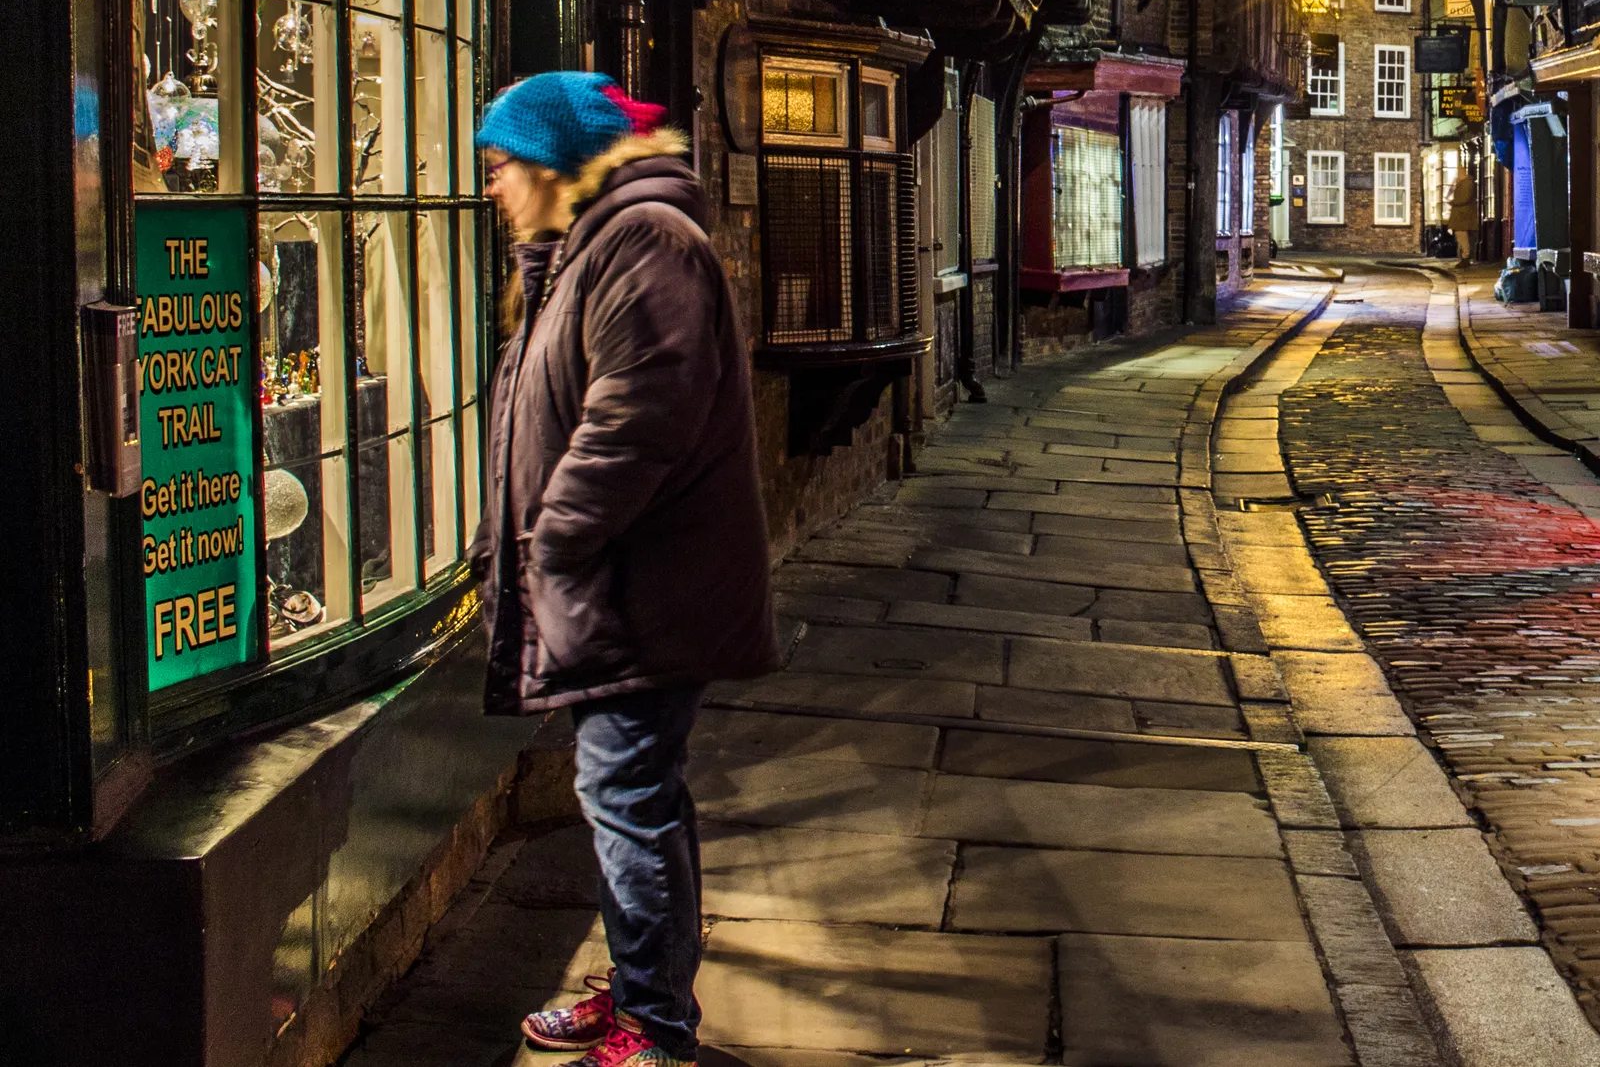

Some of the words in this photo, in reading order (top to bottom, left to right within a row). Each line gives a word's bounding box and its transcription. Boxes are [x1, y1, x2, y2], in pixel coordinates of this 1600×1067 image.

[165, 239, 209, 276] THE
[116, 313, 136, 338] FREE
[139, 350, 197, 391] YORK
[201, 346, 242, 384] CAT
[158, 404, 221, 446] TRAIL
[141, 477, 178, 517] Get
[181, 472, 194, 509] it
[198, 471, 240, 507] here
[143, 534, 178, 574] Get
[181, 529, 194, 566] it
[198, 517, 244, 561] now!
[154, 584, 237, 658] FREE
